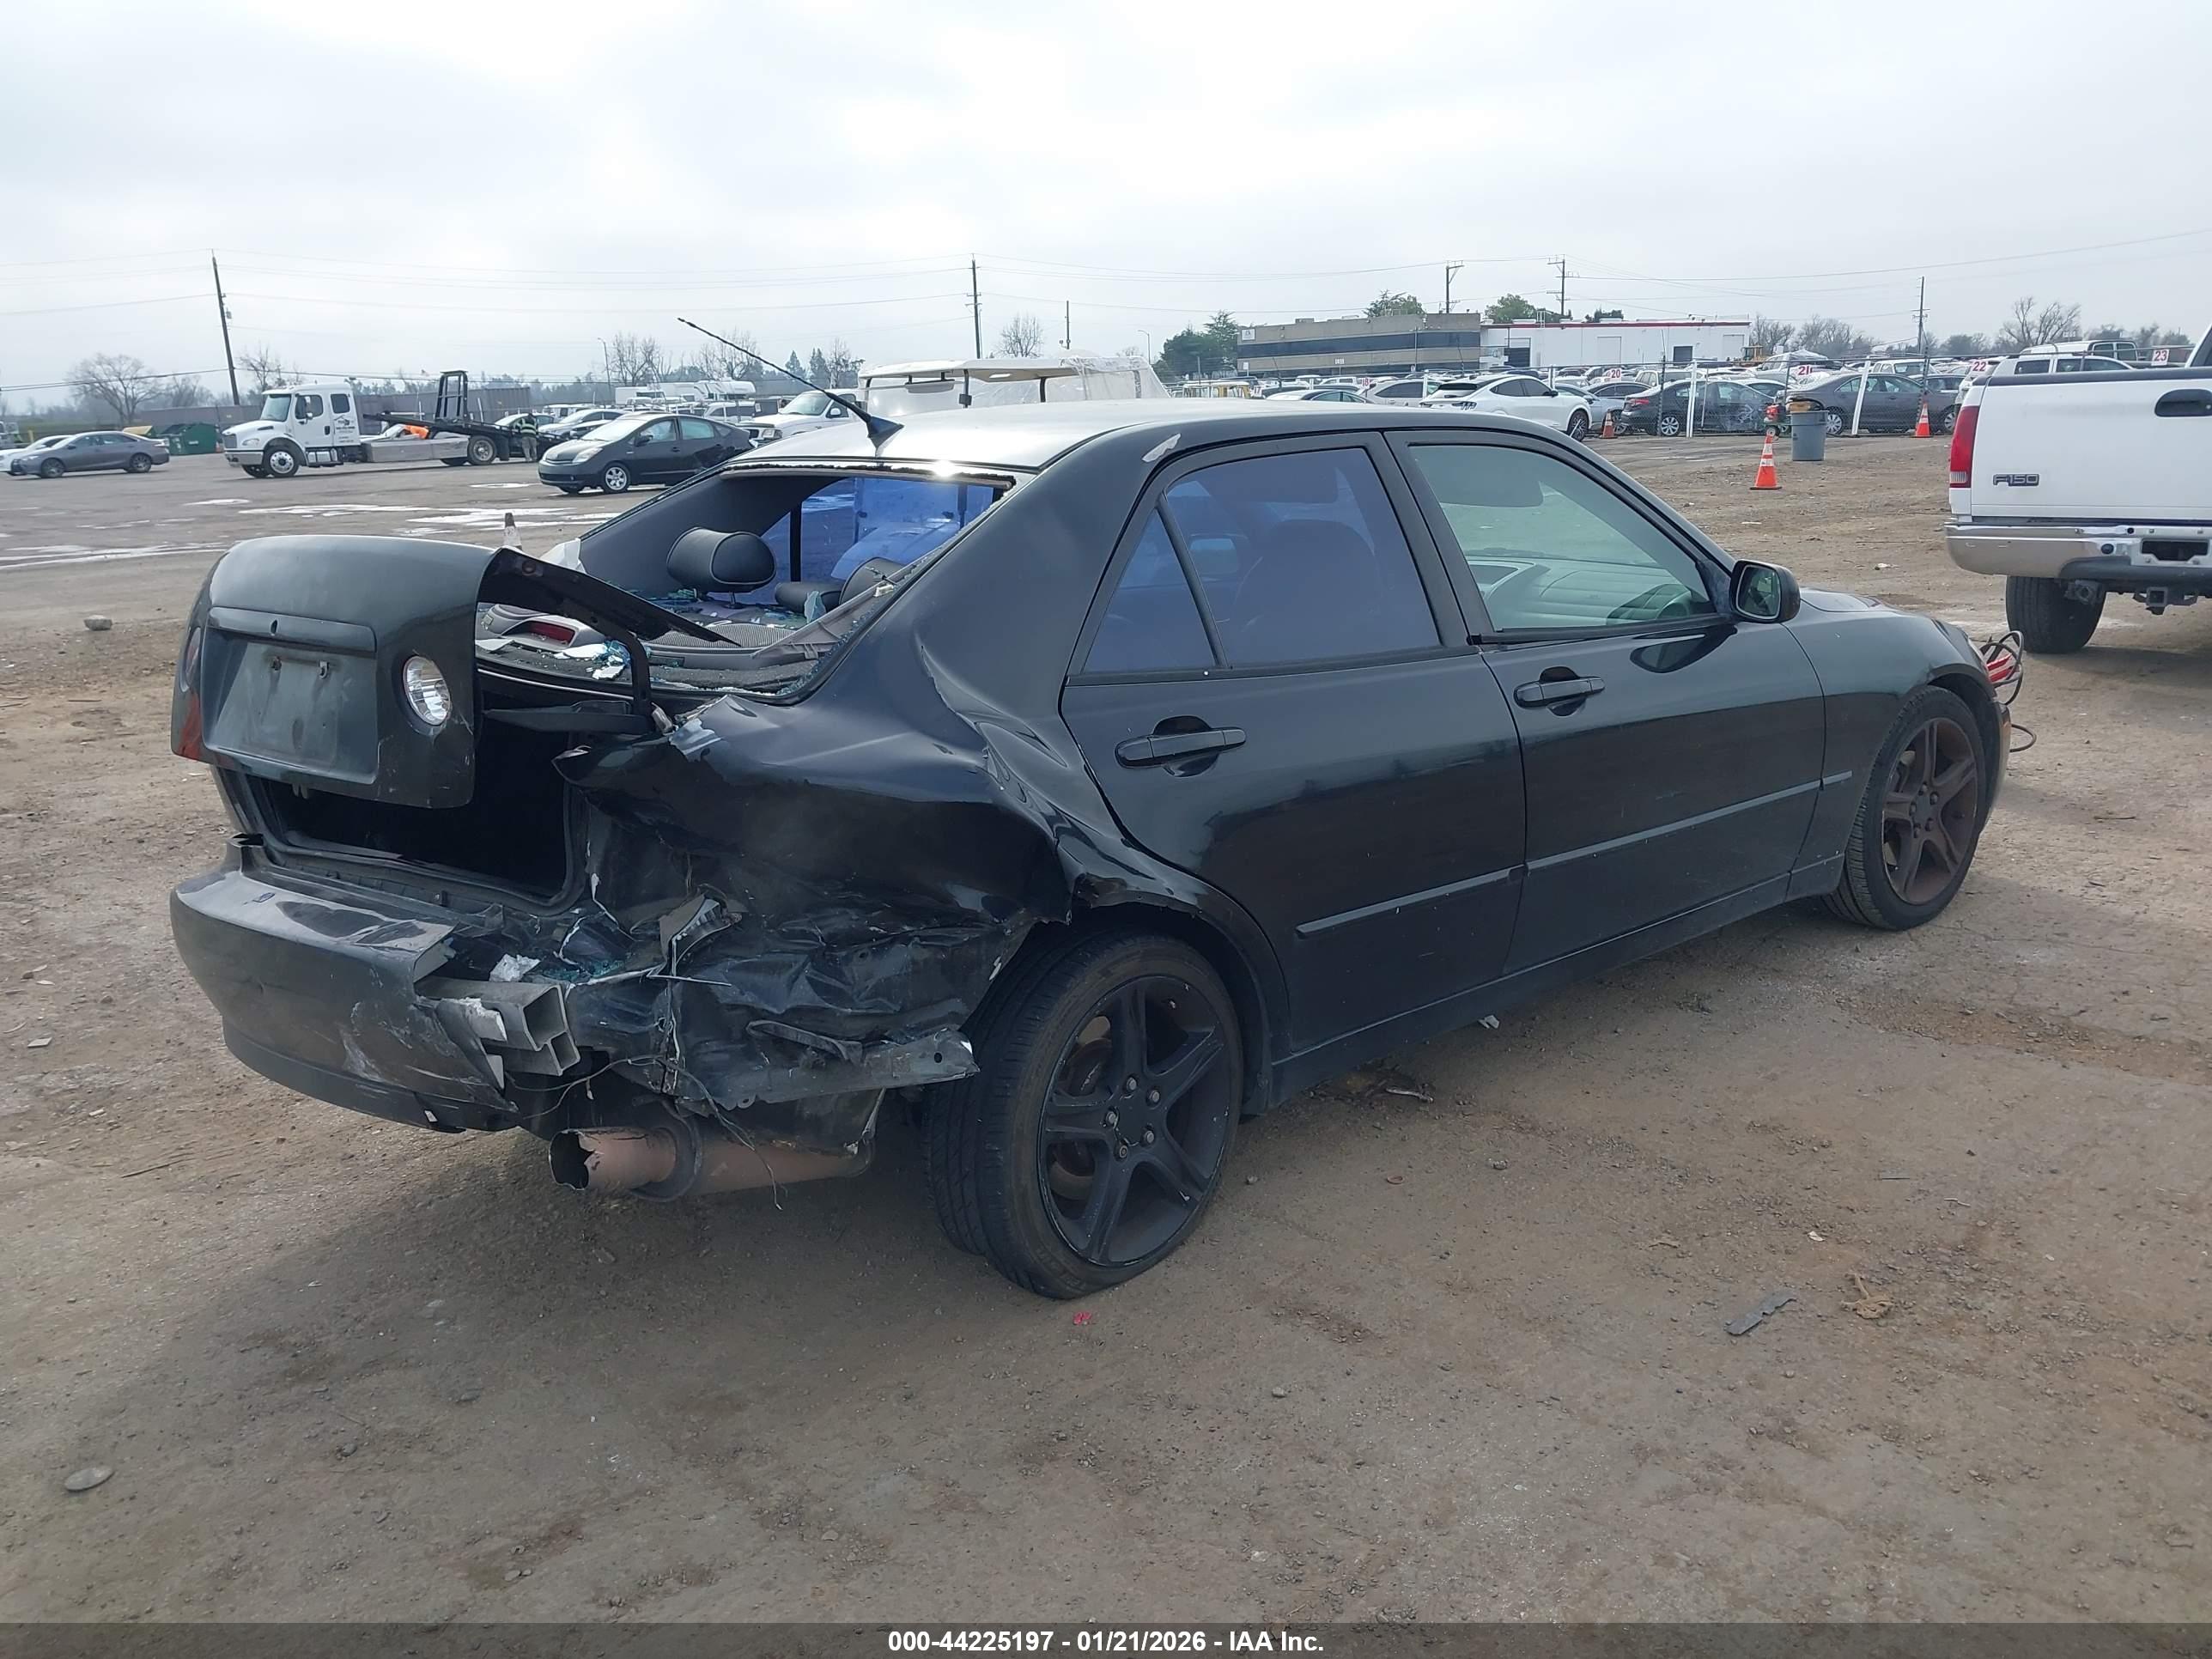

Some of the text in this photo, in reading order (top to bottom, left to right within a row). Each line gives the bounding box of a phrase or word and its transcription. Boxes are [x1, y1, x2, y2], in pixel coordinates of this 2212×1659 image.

[2154, 350, 2167, 362] 23
[1798, 365, 1810, 375] 21
[1972, 361, 1986, 372] 22
[1611, 369, 1621, 379] 20
